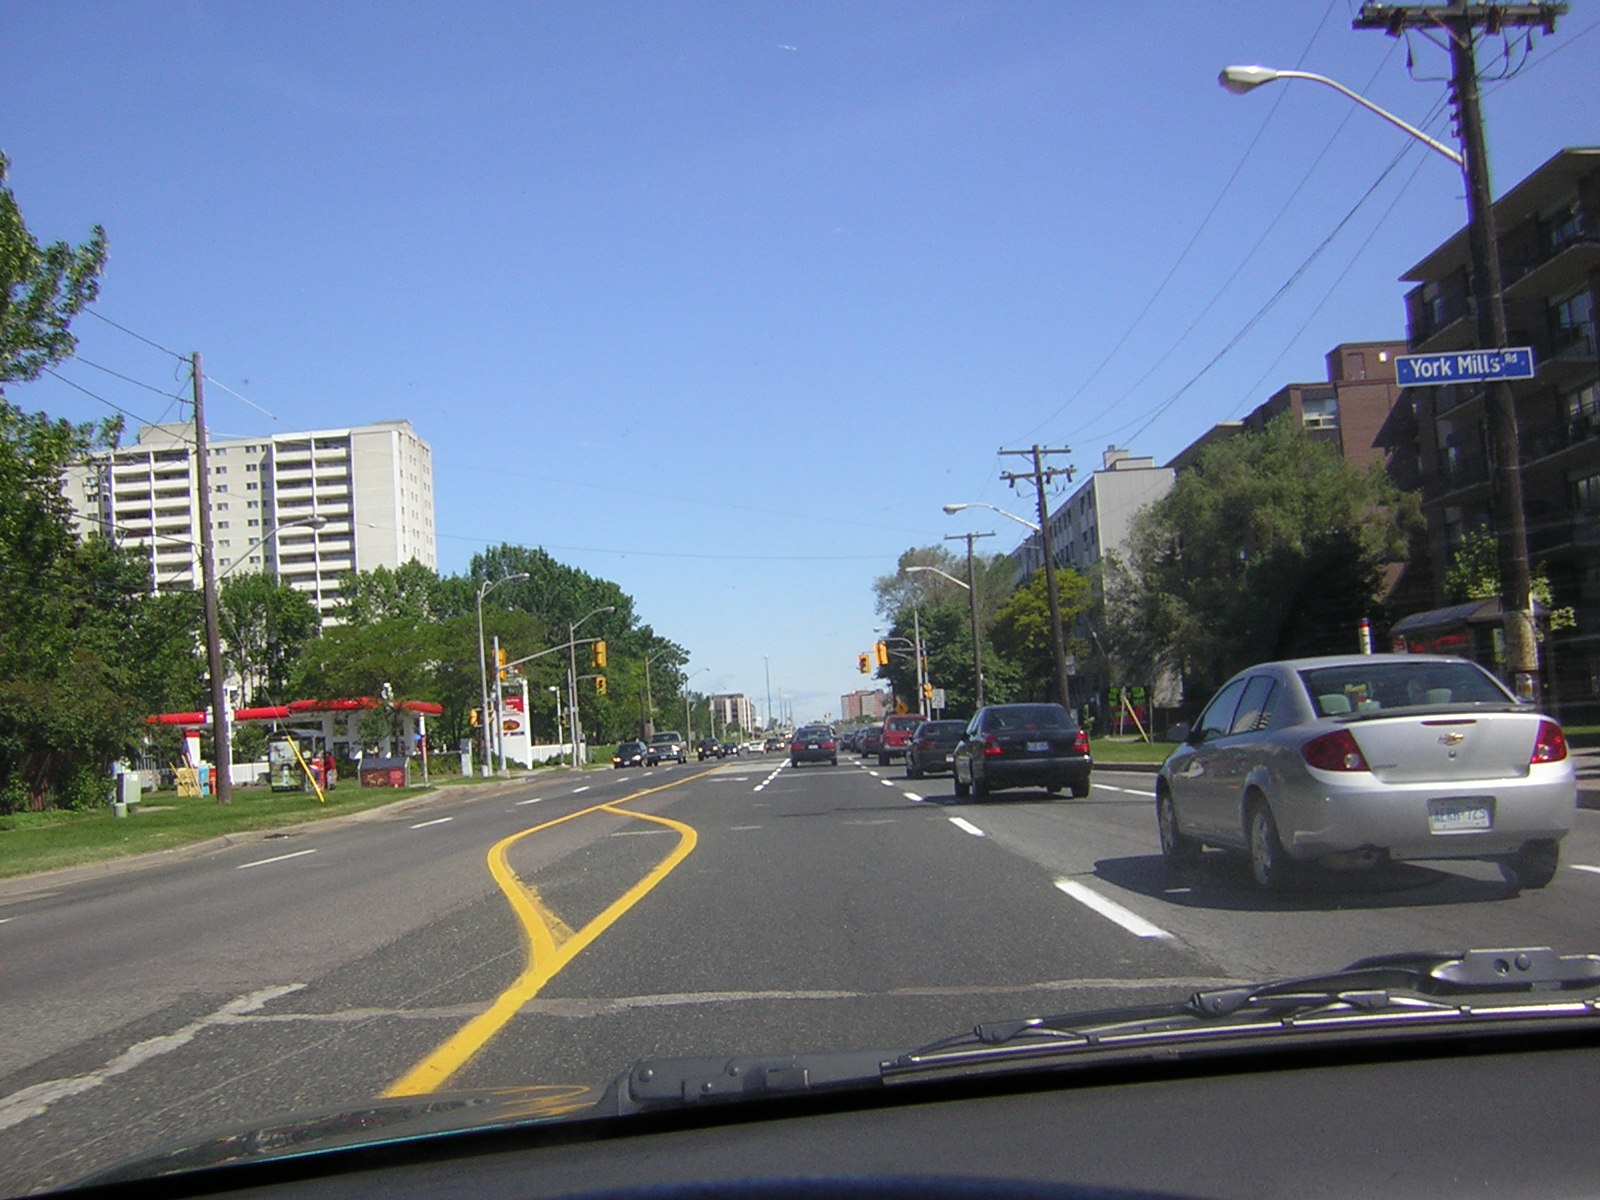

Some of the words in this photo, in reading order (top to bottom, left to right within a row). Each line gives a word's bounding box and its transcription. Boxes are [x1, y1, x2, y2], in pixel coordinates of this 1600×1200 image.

[1409, 357, 1452, 378] York
[1457, 354, 1501, 375] Mills
[1504, 353, 1517, 364] Rd
